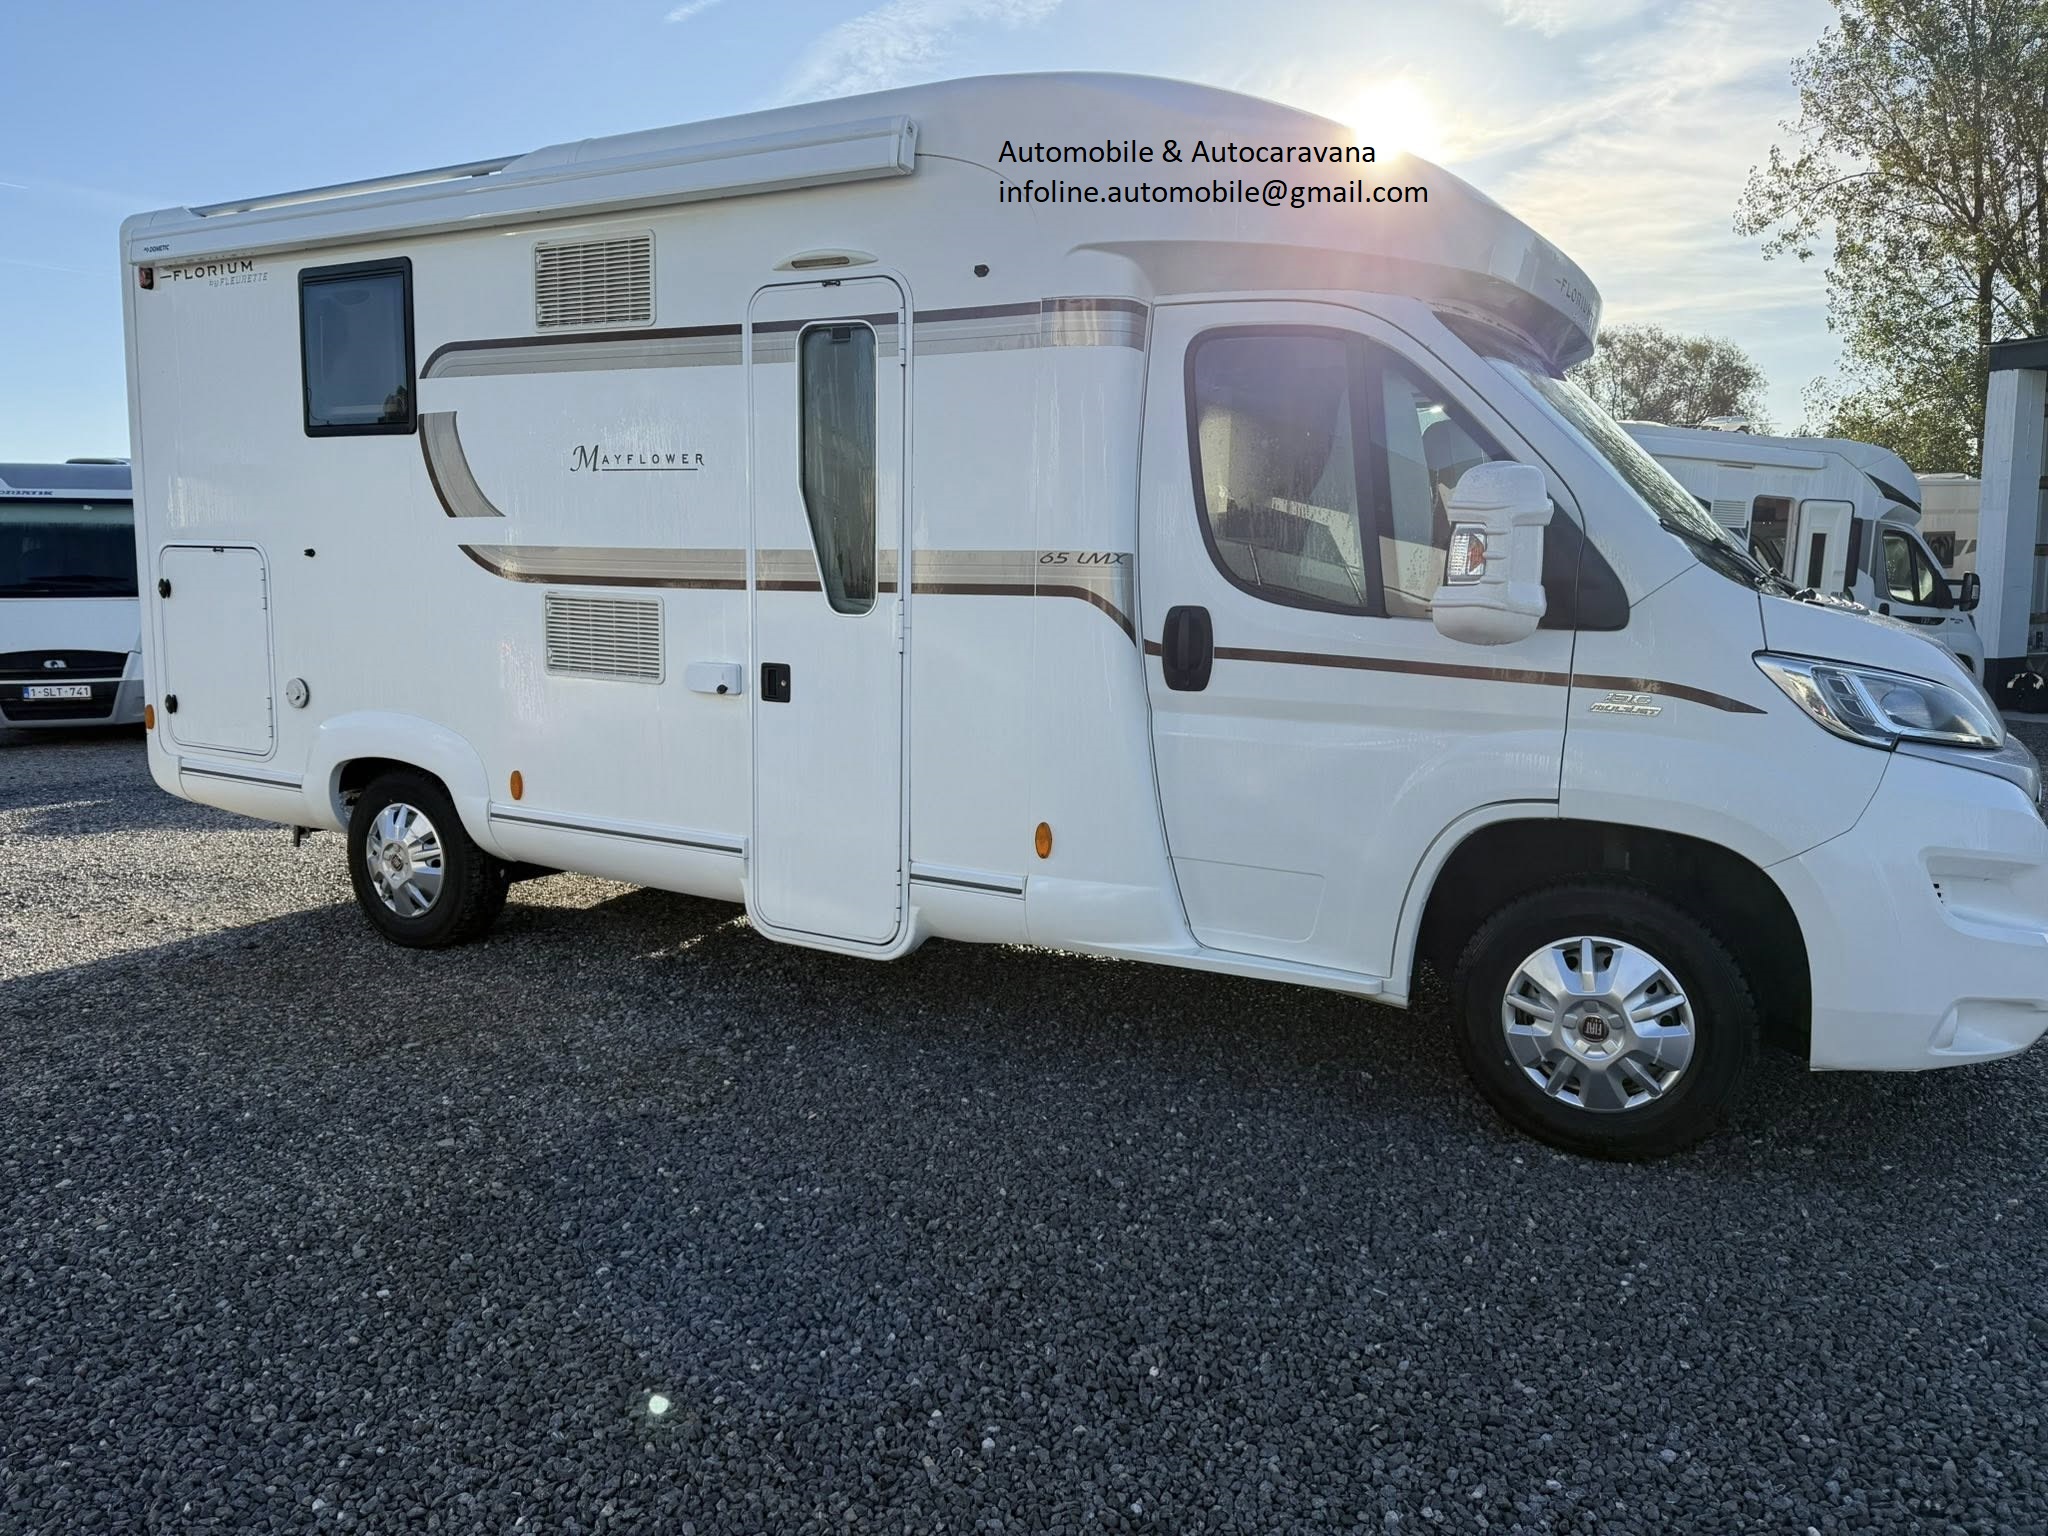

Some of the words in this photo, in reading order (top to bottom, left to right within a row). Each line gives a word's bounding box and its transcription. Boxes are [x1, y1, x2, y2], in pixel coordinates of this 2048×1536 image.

[173, 260, 253, 281] FLORIUM
[219, 272, 268, 287] FLEURETTE
[1039, 552, 1070, 565] 65
[1076, 552, 1129, 566] LMX
